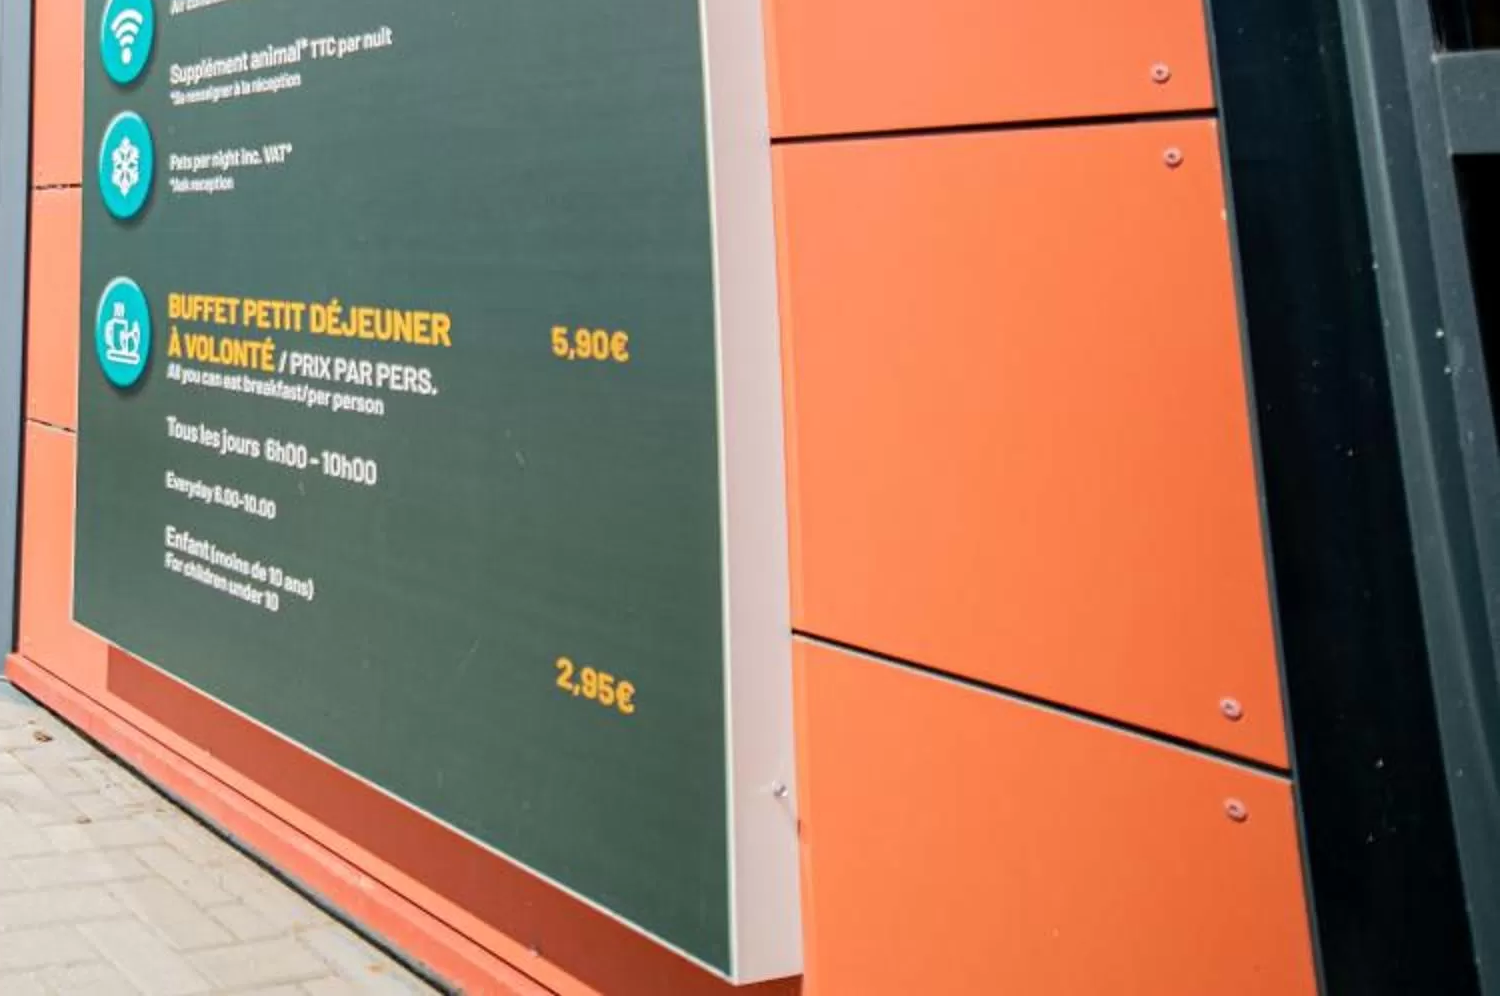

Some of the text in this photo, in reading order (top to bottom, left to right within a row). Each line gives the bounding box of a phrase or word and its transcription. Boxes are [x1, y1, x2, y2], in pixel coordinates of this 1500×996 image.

[169, 52, 248, 86] Supplément
[310, 36, 337, 60] TTC
[363, 25, 392, 49] nuit
[211, 148, 240, 171] night
[168, 293, 452, 347] BUFFET PETIT DÉJEUNER
[551, 326, 629, 362] 5,90€
[168, 326, 182, 358] À
[184, 333, 276, 372] VOLONTÉ
[289, 351, 331, 382] PRIX
[334, 357, 373, 387] PAR
[375, 363, 438, 396] PERS.
[181, 367, 201, 385] you
[332, 392, 384, 415] person
[166, 416, 199, 444] Tous
[199, 423, 221, 448] les
[221, 428, 260, 457] jours
[264, 438, 306, 469] 6h00
[321, 450, 378, 486] 10h00
[165, 526, 209, 561] Enfant
[250, 561, 267, 581] de
[267, 566, 283, 588] 10
[284, 575, 314, 601] ans)
[165, 552, 183, 573] For
[263, 591, 279, 612] 10
